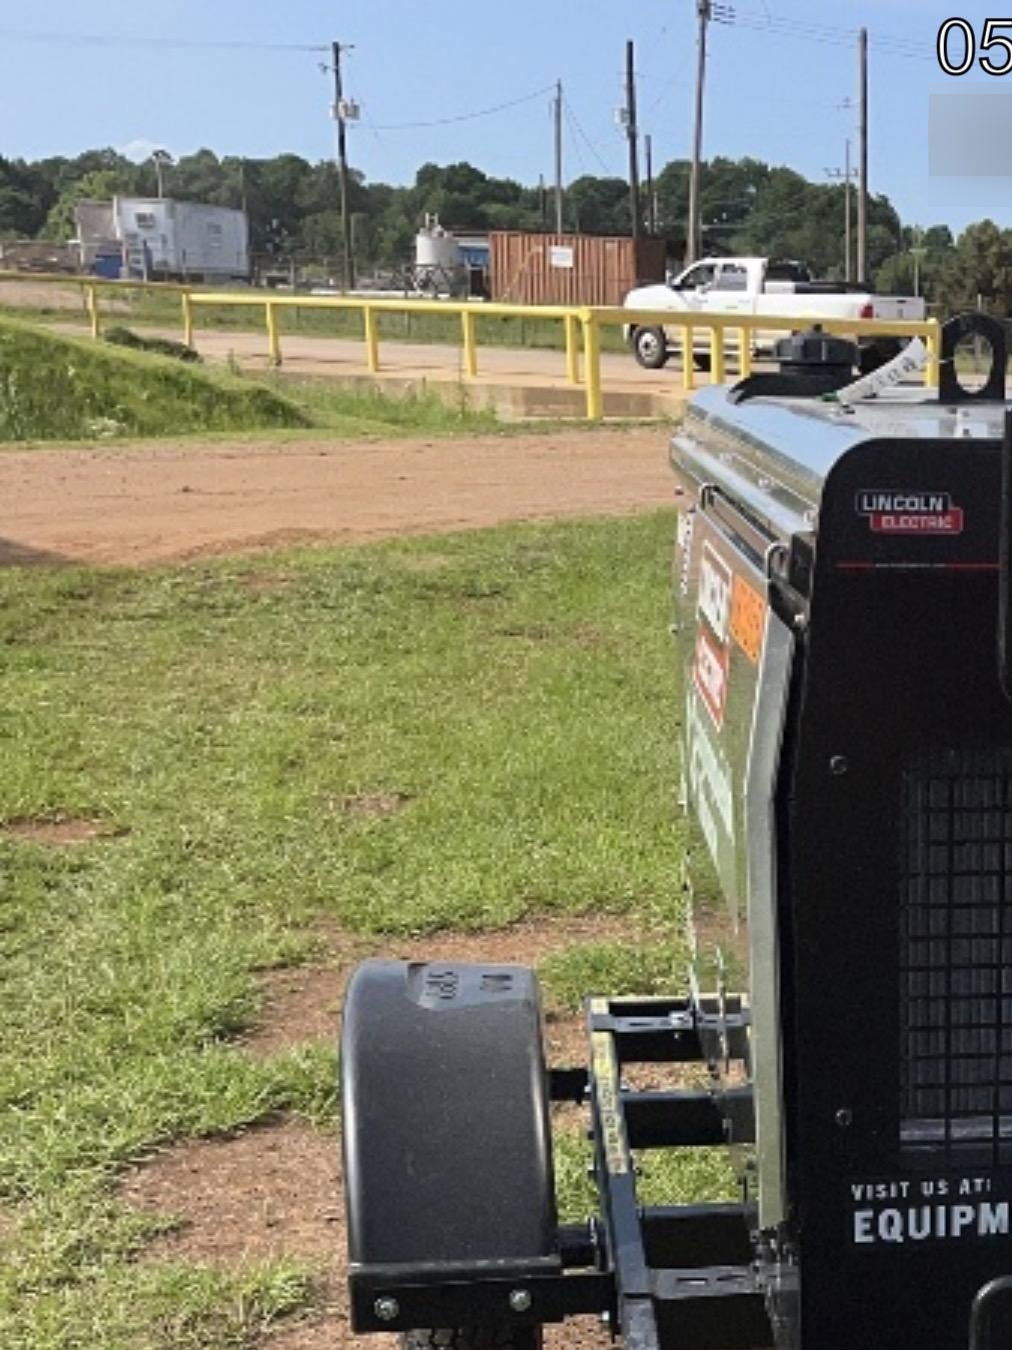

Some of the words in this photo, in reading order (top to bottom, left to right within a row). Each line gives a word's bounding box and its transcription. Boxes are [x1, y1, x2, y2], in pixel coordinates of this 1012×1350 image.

[862, 494, 943, 511] LINCOLN
[881, 515, 953, 529] ELECTRIC
[851, 1181, 910, 1202] VISIT
[921, 1179, 949, 1196] US
